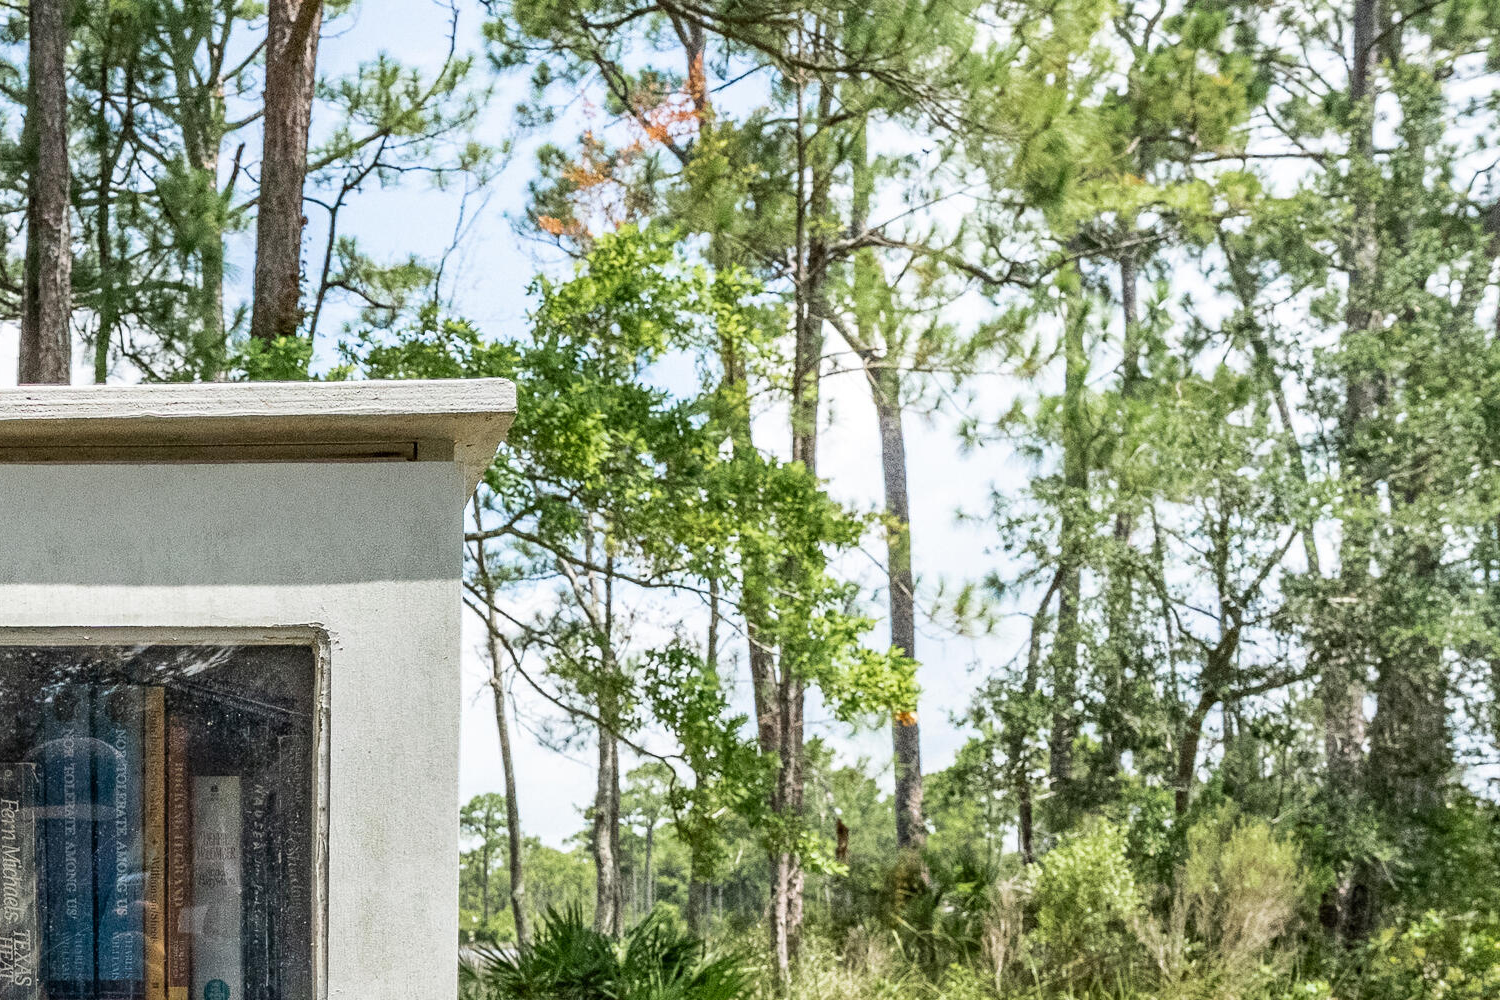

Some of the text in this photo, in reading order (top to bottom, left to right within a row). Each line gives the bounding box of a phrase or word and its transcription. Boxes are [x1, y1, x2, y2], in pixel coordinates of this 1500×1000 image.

[62, 728, 75, 758] NOR
[63, 763, 76, 836] TOLERATE
[116, 763, 127, 836] TOLERATE
[173, 763, 184, 830] ROCKING
[0, 799, 22, 923] Fern Michaels
[65, 841, 77, 892] AMONG
[116, 841, 128, 893] AMONG
[174, 849, 184, 908] GRAND
[0, 936, 14, 983] HEAT
[13, 930, 32, 986] TEXAS
